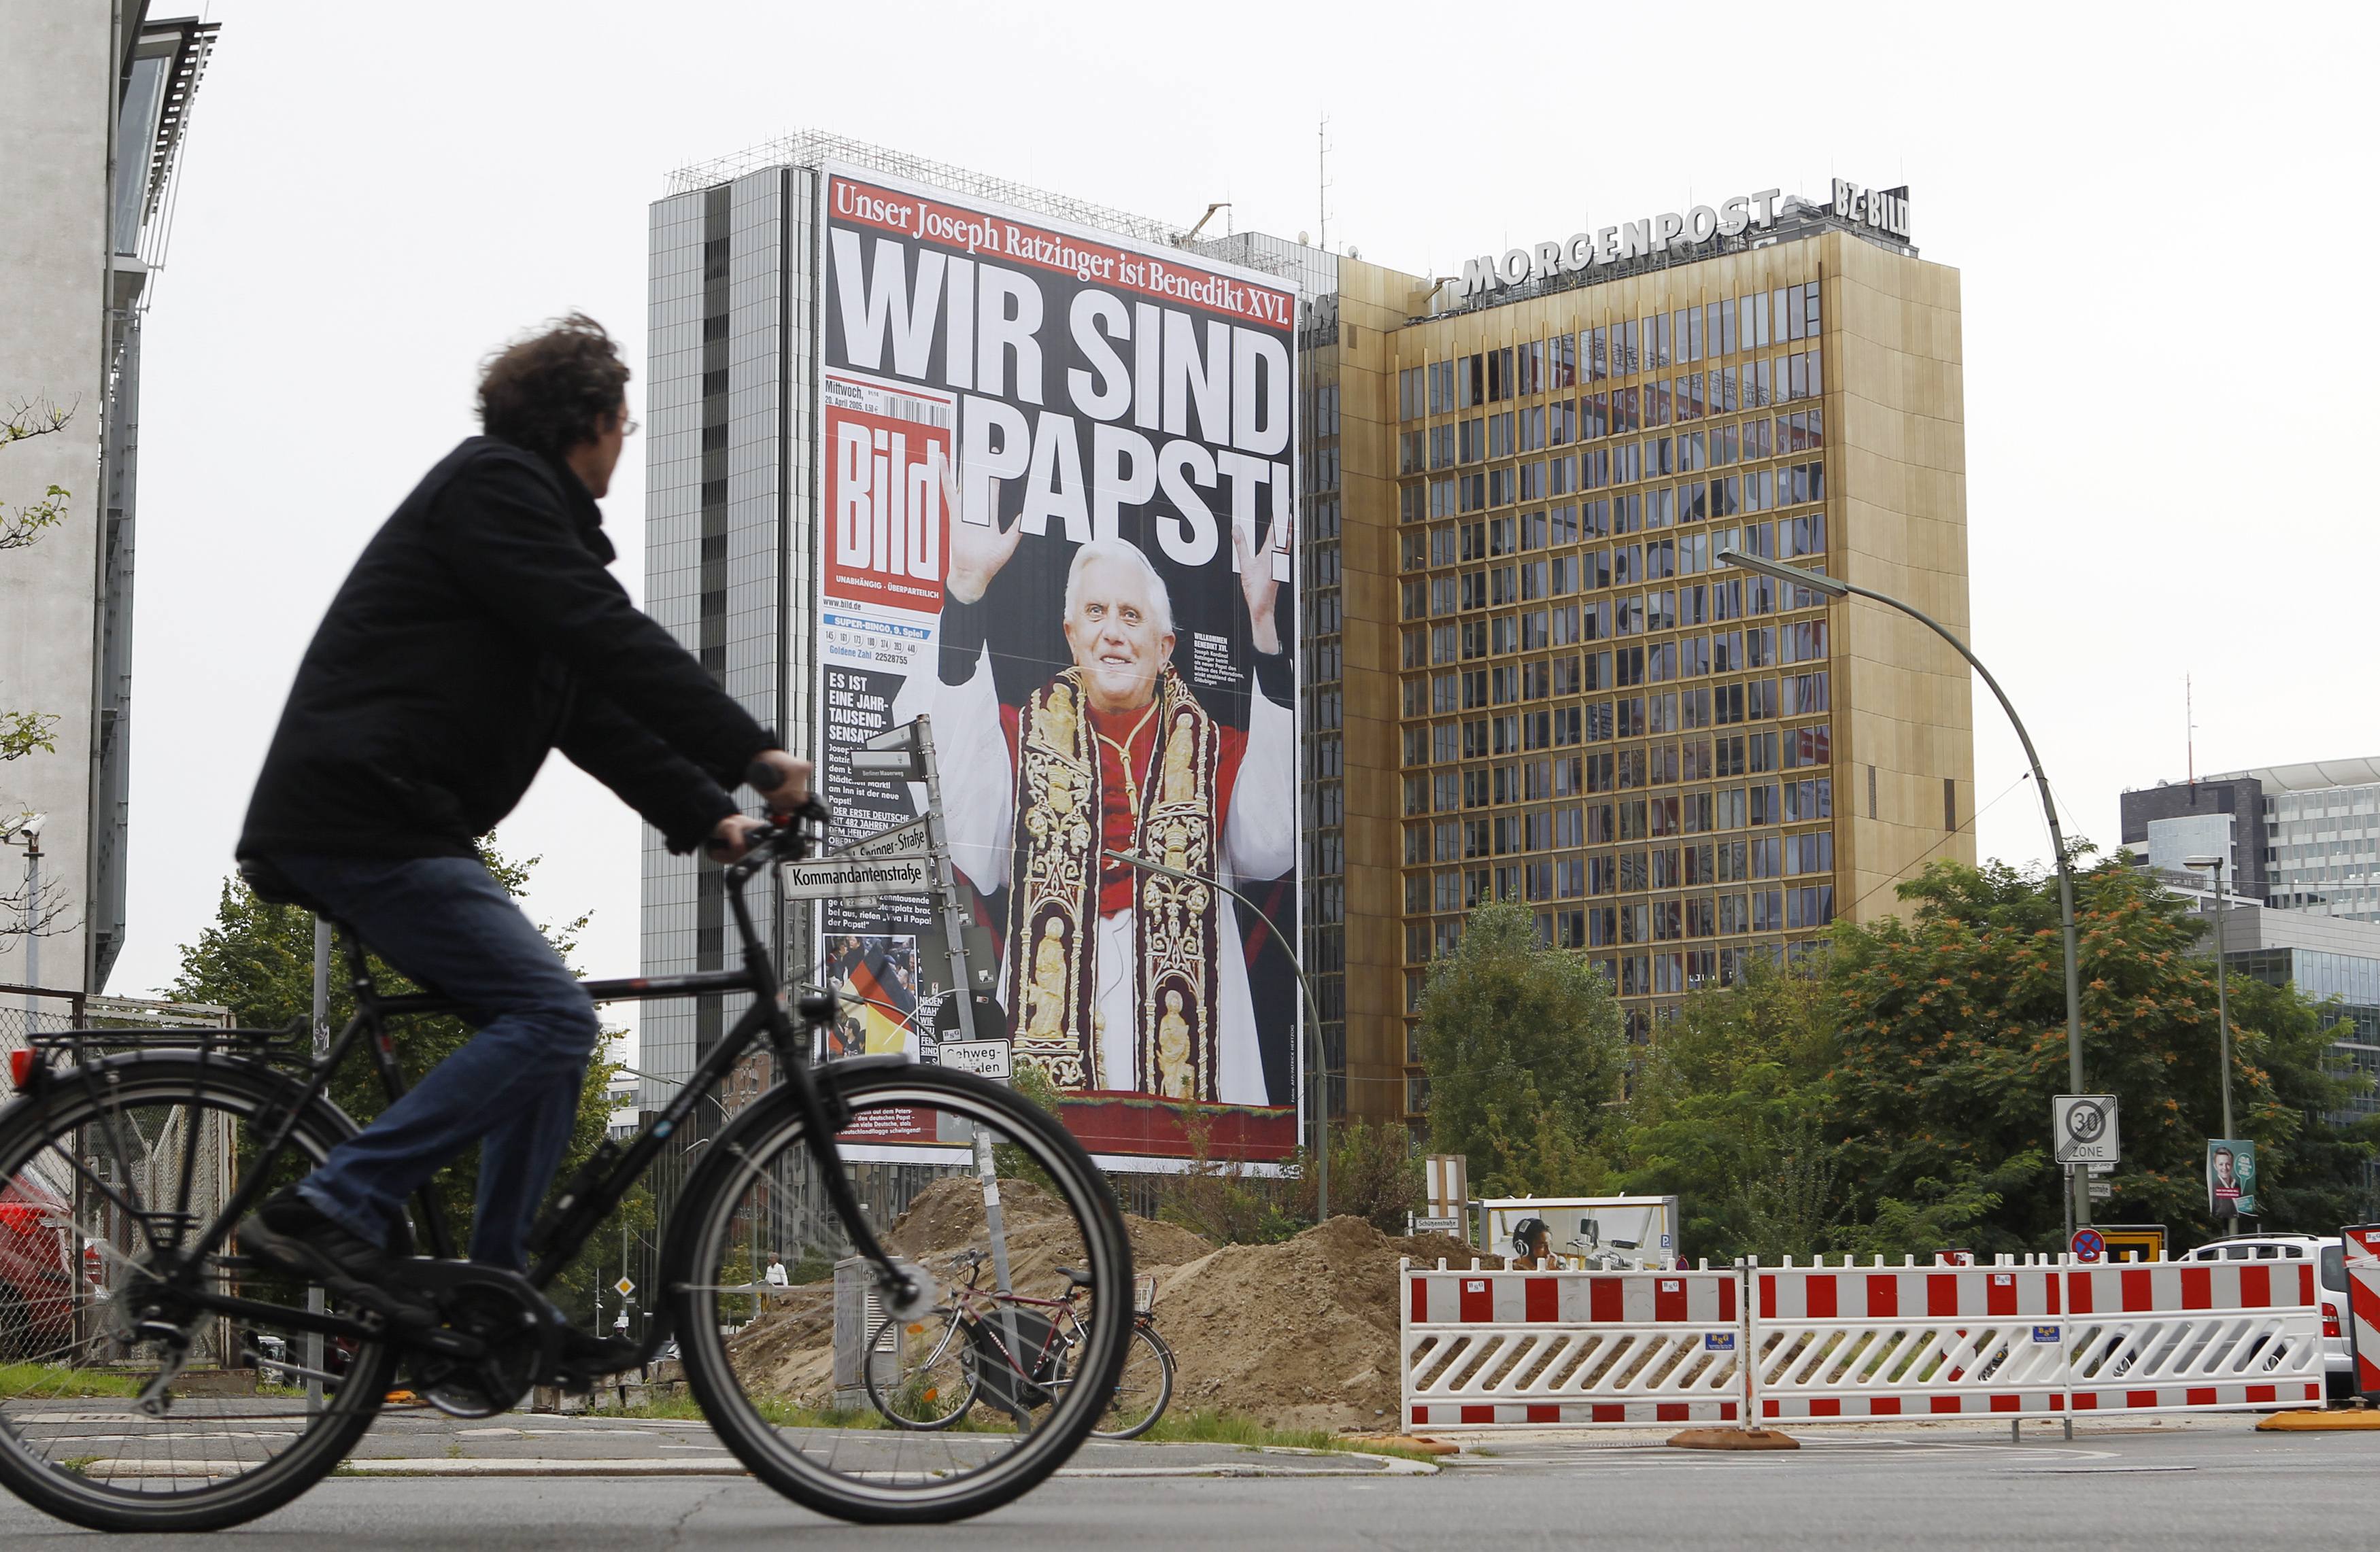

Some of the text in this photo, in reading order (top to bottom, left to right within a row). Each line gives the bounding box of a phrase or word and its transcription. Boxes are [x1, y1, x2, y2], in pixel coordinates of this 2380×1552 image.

[1459, 188, 1780, 298] MORGENPOST
[836, 182, 911, 228] Unser
[913, 203, 1000, 255] Joseph
[1004, 225, 1114, 282] Ratzinger
[1119, 253, 1146, 288] ist
[1149, 263, 1244, 313] Benedikt
[1246, 288, 1289, 325] XVI.
[830, 227, 1291, 456] WIR SIND
[826, 380, 864, 401] Mittwoch,
[825, 396, 834, 404] 20.
[835, 398, 848, 407] April
[962, 394, 1291, 583] PAPST!
[836, 420, 940, 583] Bild
[836, 575, 939, 599] UNABHÄNGIG ÜBERPARTEILICH
[823, 598, 861, 610] www.bild.de
[834, 617, 923, 638] SUPER-BINGO, 9. Spiel
[1194, 632, 1227, 645] WILLKOMMEN
[1194, 640, 1217, 651] BENEDIKT
[830, 645, 908, 665] Goldene Zahl 22528755
[829, 672, 868, 691] ES IST
[829, 689, 889, 712] EINE JAHR-
[829, 707, 887, 728] TAUSEND-
[828, 765, 845, 774] dem
[828, 795, 851, 806] Papst!
[843, 786, 854, 795] Inn
[856, 788, 864, 796] ist
[867, 789, 879, 798] der
[833, 806, 910, 822] DER ERSTE DEUTSCHE
[845, 818, 858, 827] 482
[860, 820, 888, 830] JAHREN
[792, 862, 922, 886] Kommandantenstraße
[828, 899, 838, 908] ge
[828, 908, 840, 916] bel
[843, 910, 857, 918] aus,
[860, 911, 881, 920] riefen
[904, 914, 908, 922] il
[911, 915, 932, 925] Papa!
[828, 918, 840, 927] der
[944, 1030, 959, 1039] BSG
[2074, 1112, 2098, 1132] 30
[2073, 1146, 2103, 1157] ZONE
[1663, 1236, 1669, 1247] P
